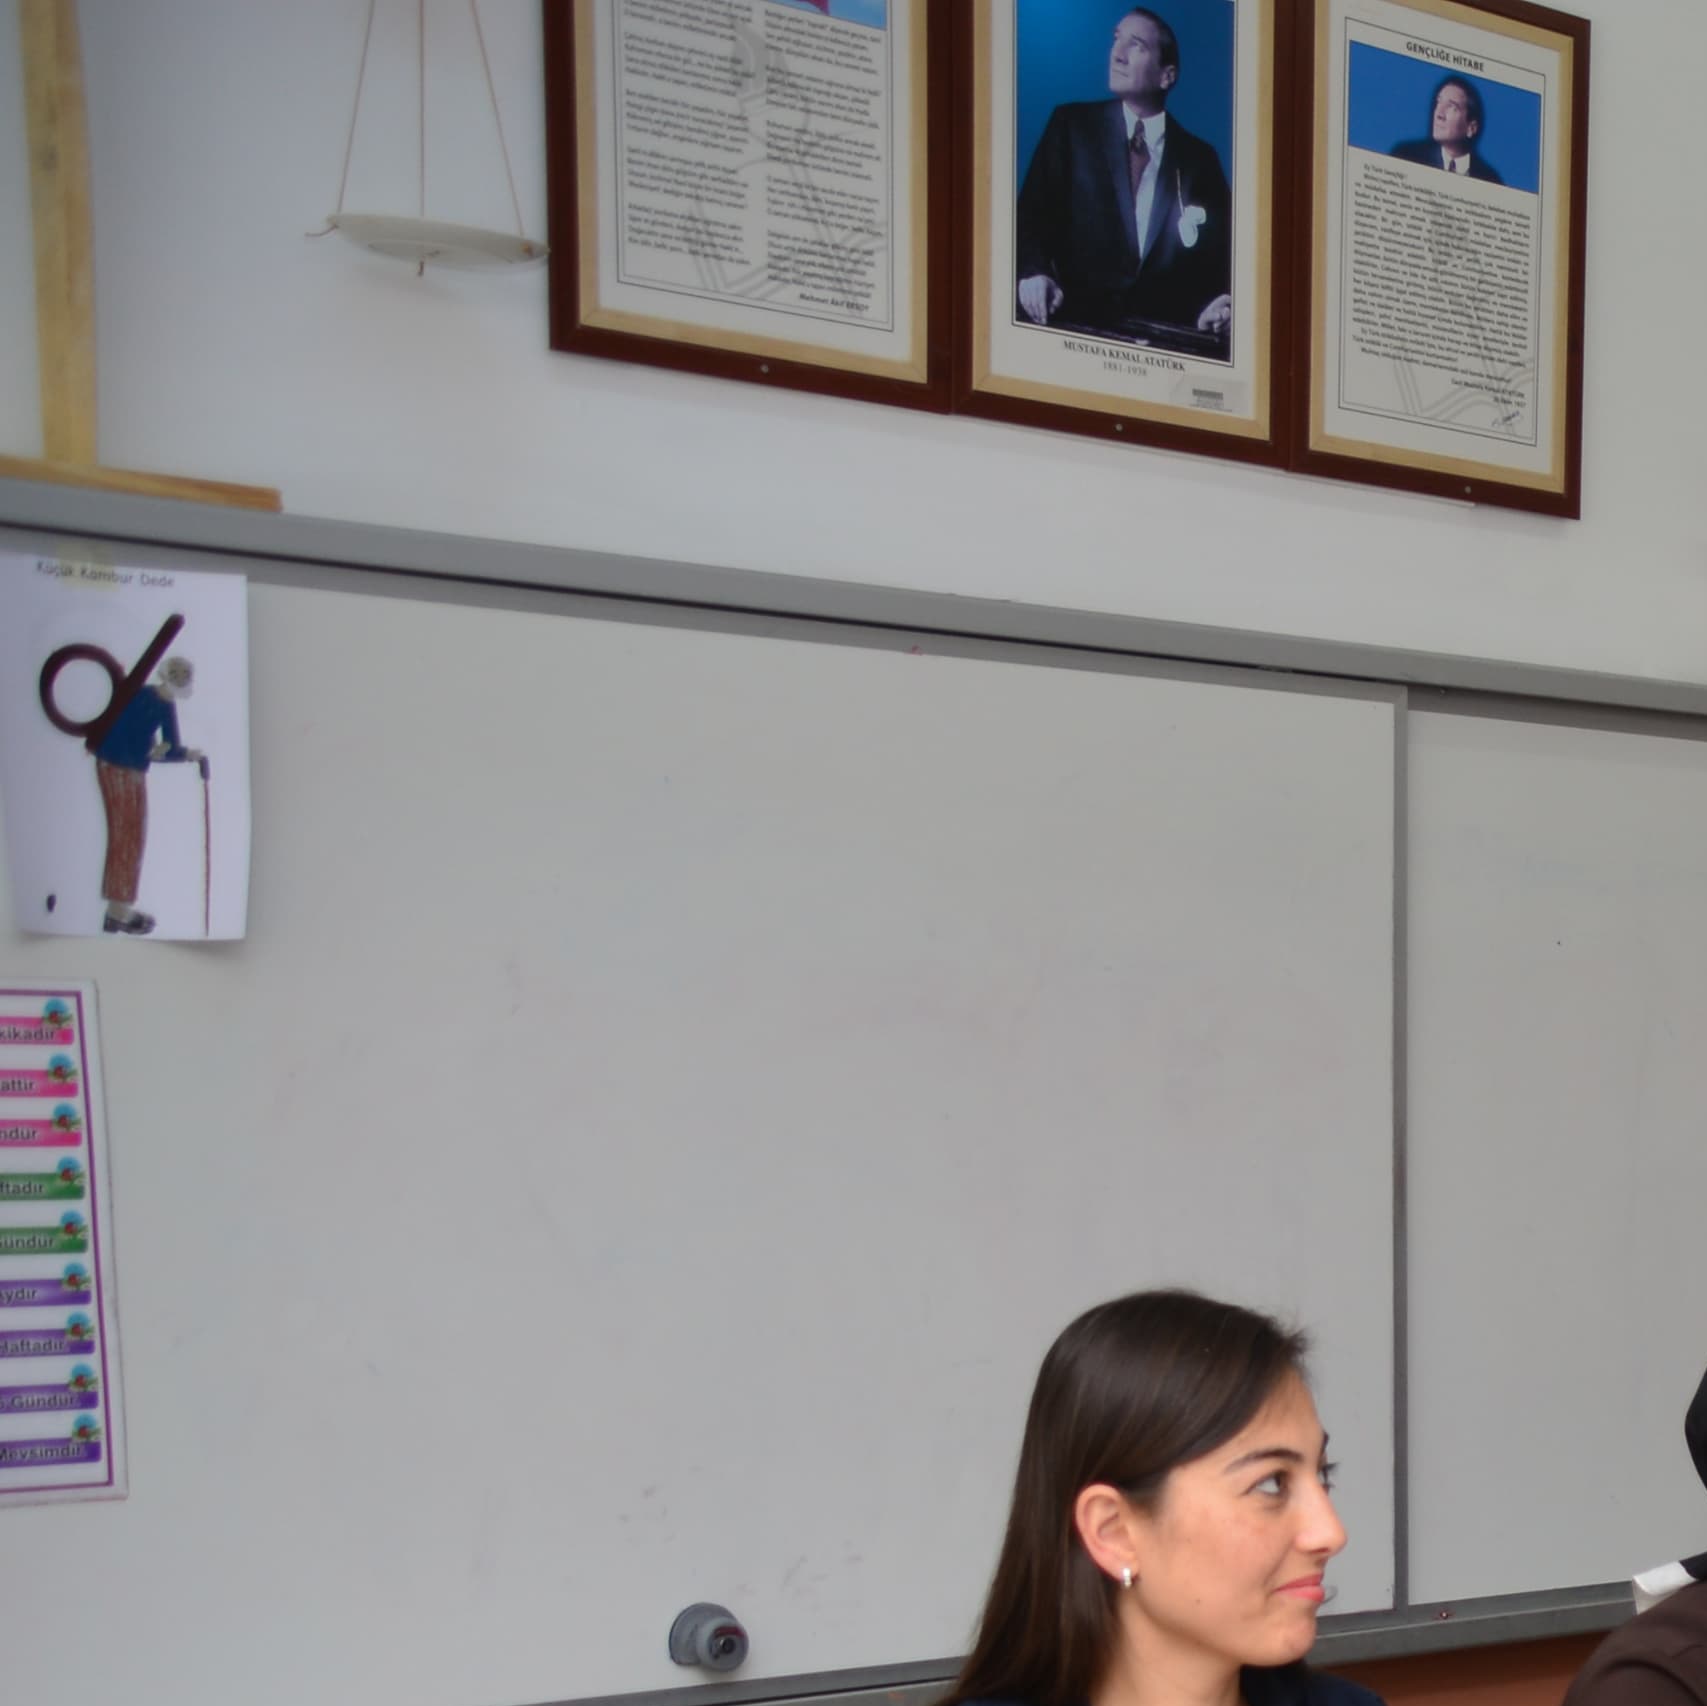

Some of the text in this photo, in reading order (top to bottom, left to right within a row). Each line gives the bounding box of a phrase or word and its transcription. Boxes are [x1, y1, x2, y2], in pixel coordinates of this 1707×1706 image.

[1406, 41, 1485, 72] GENÇLİĞE HİTABE
[1063, 340, 1185, 372] MUSTAFA KEMAL ATATÜRK
[80, 566, 134, 586] Kambur
[140, 573, 176, 588] Dede
